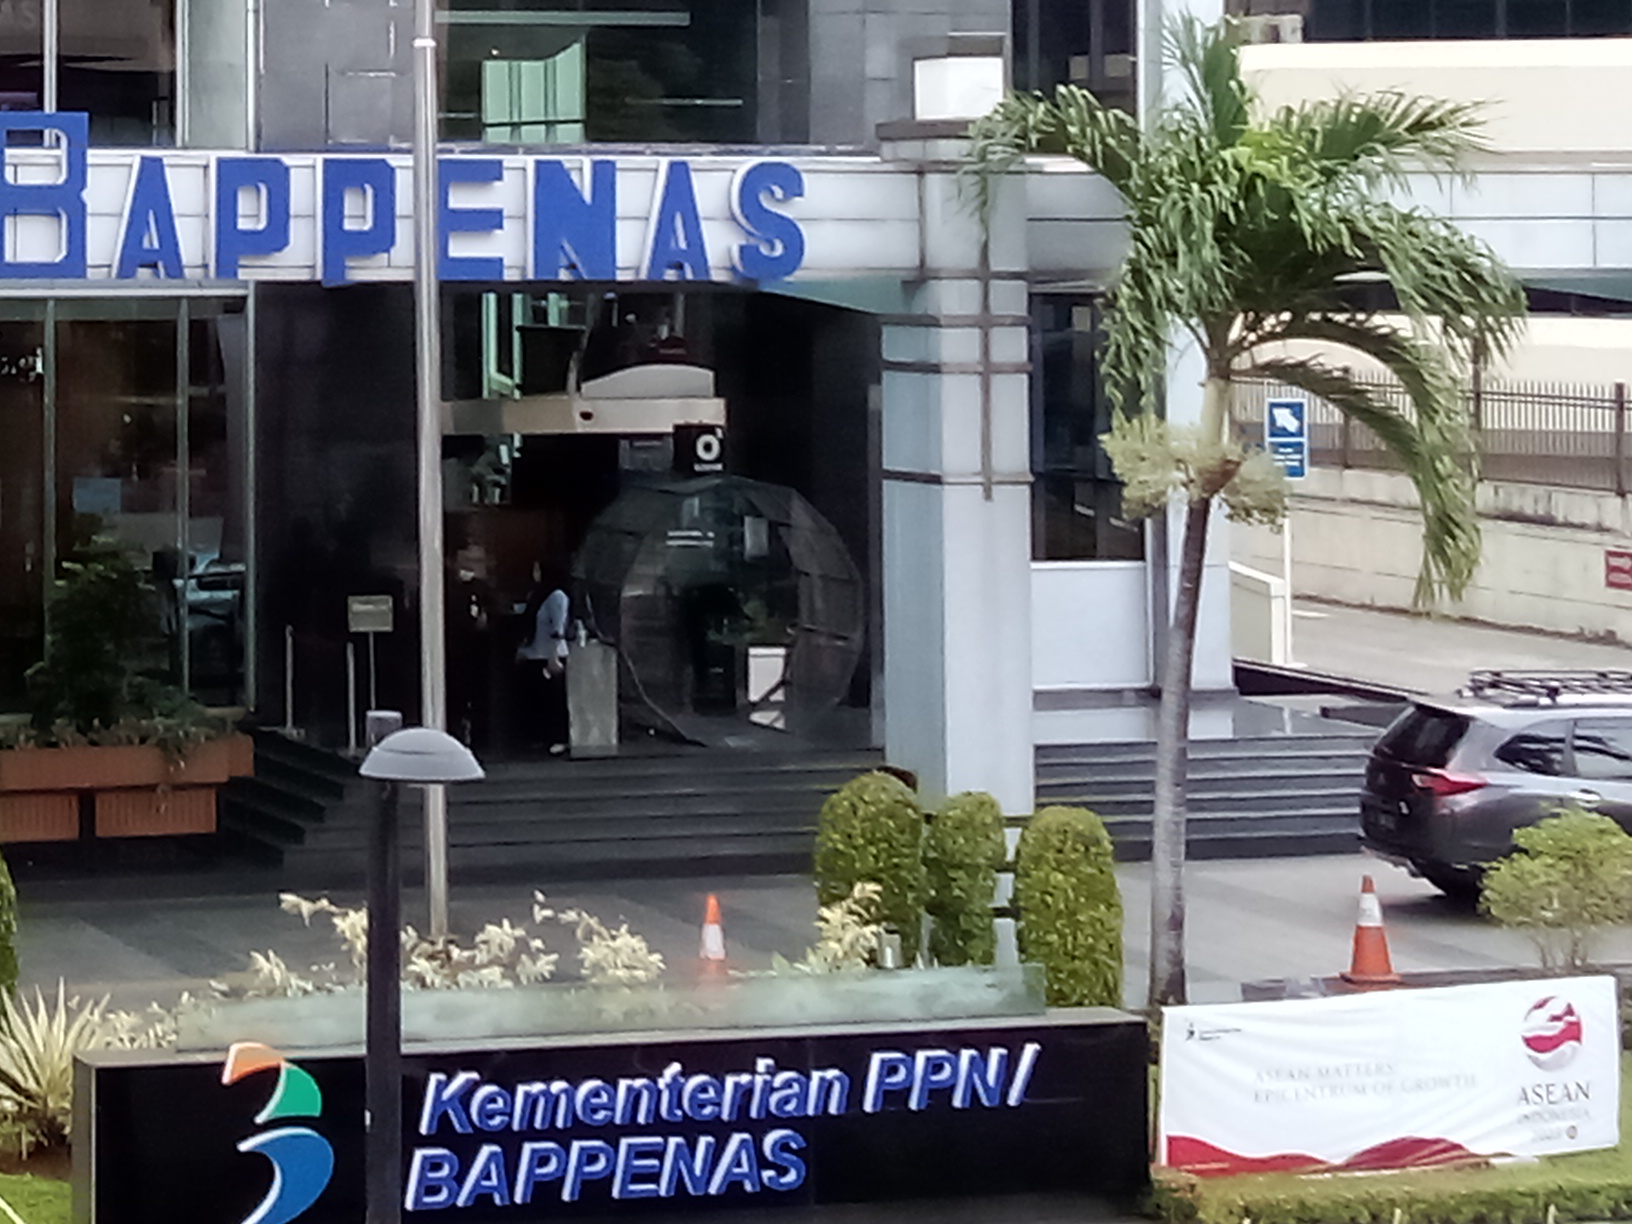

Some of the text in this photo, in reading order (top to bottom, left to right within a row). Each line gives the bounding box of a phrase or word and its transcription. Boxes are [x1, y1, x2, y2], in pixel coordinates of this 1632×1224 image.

[420, 1043, 1042, 1135] Kementerian PPN/
[1372, 1079, 1394, 1095] OF
[1400, 1072, 1478, 1093] GROWTH
[1518, 1081, 1591, 1105] ASEAN
[404, 1130, 808, 1212] BAPPENAS
